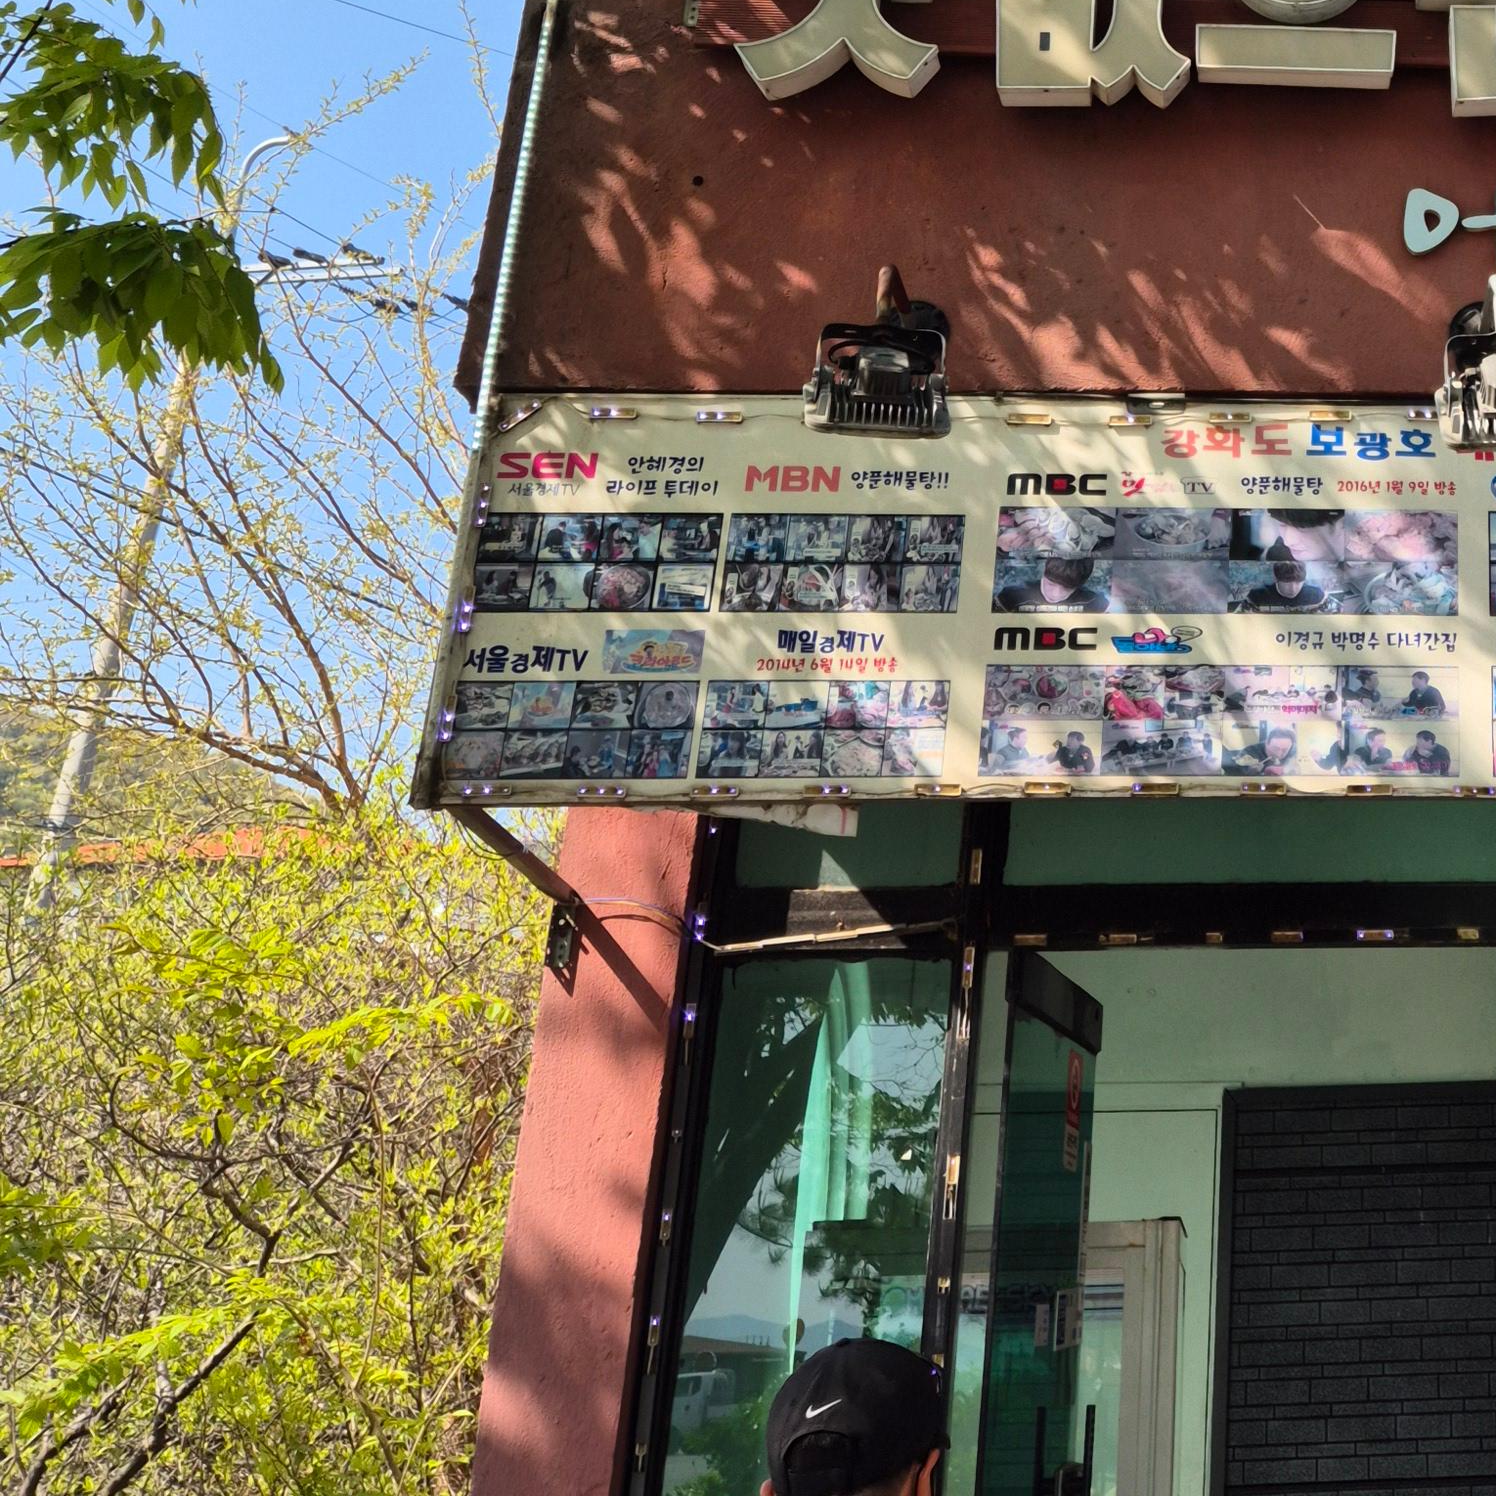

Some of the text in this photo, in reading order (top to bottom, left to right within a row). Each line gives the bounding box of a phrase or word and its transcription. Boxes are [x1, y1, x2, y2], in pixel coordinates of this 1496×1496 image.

[1160, 423, 1293, 459] 강화도
[1306, 424, 1437, 461] 보광호
[496, 450, 599, 480] SEN
[627, 455, 705, 474] 안혜경의
[605, 479, 719, 498] 라이프 투데이
[744, 464, 842, 493] MBN
[1186, 480, 1213, 494] TV
[1240, 475, 1324, 497] 양푼해물탕
[1337, 479, 1457, 496] 2016년 1월 9일 방송
[777, 629, 885, 654] 매일경제TV
[1275, 631, 1458, 653] 이경규 박명수 다녀간집
[462, 644, 589, 675] 서울경제TV
[756, 657, 899, 674] 2014년 6월 14일 방송
